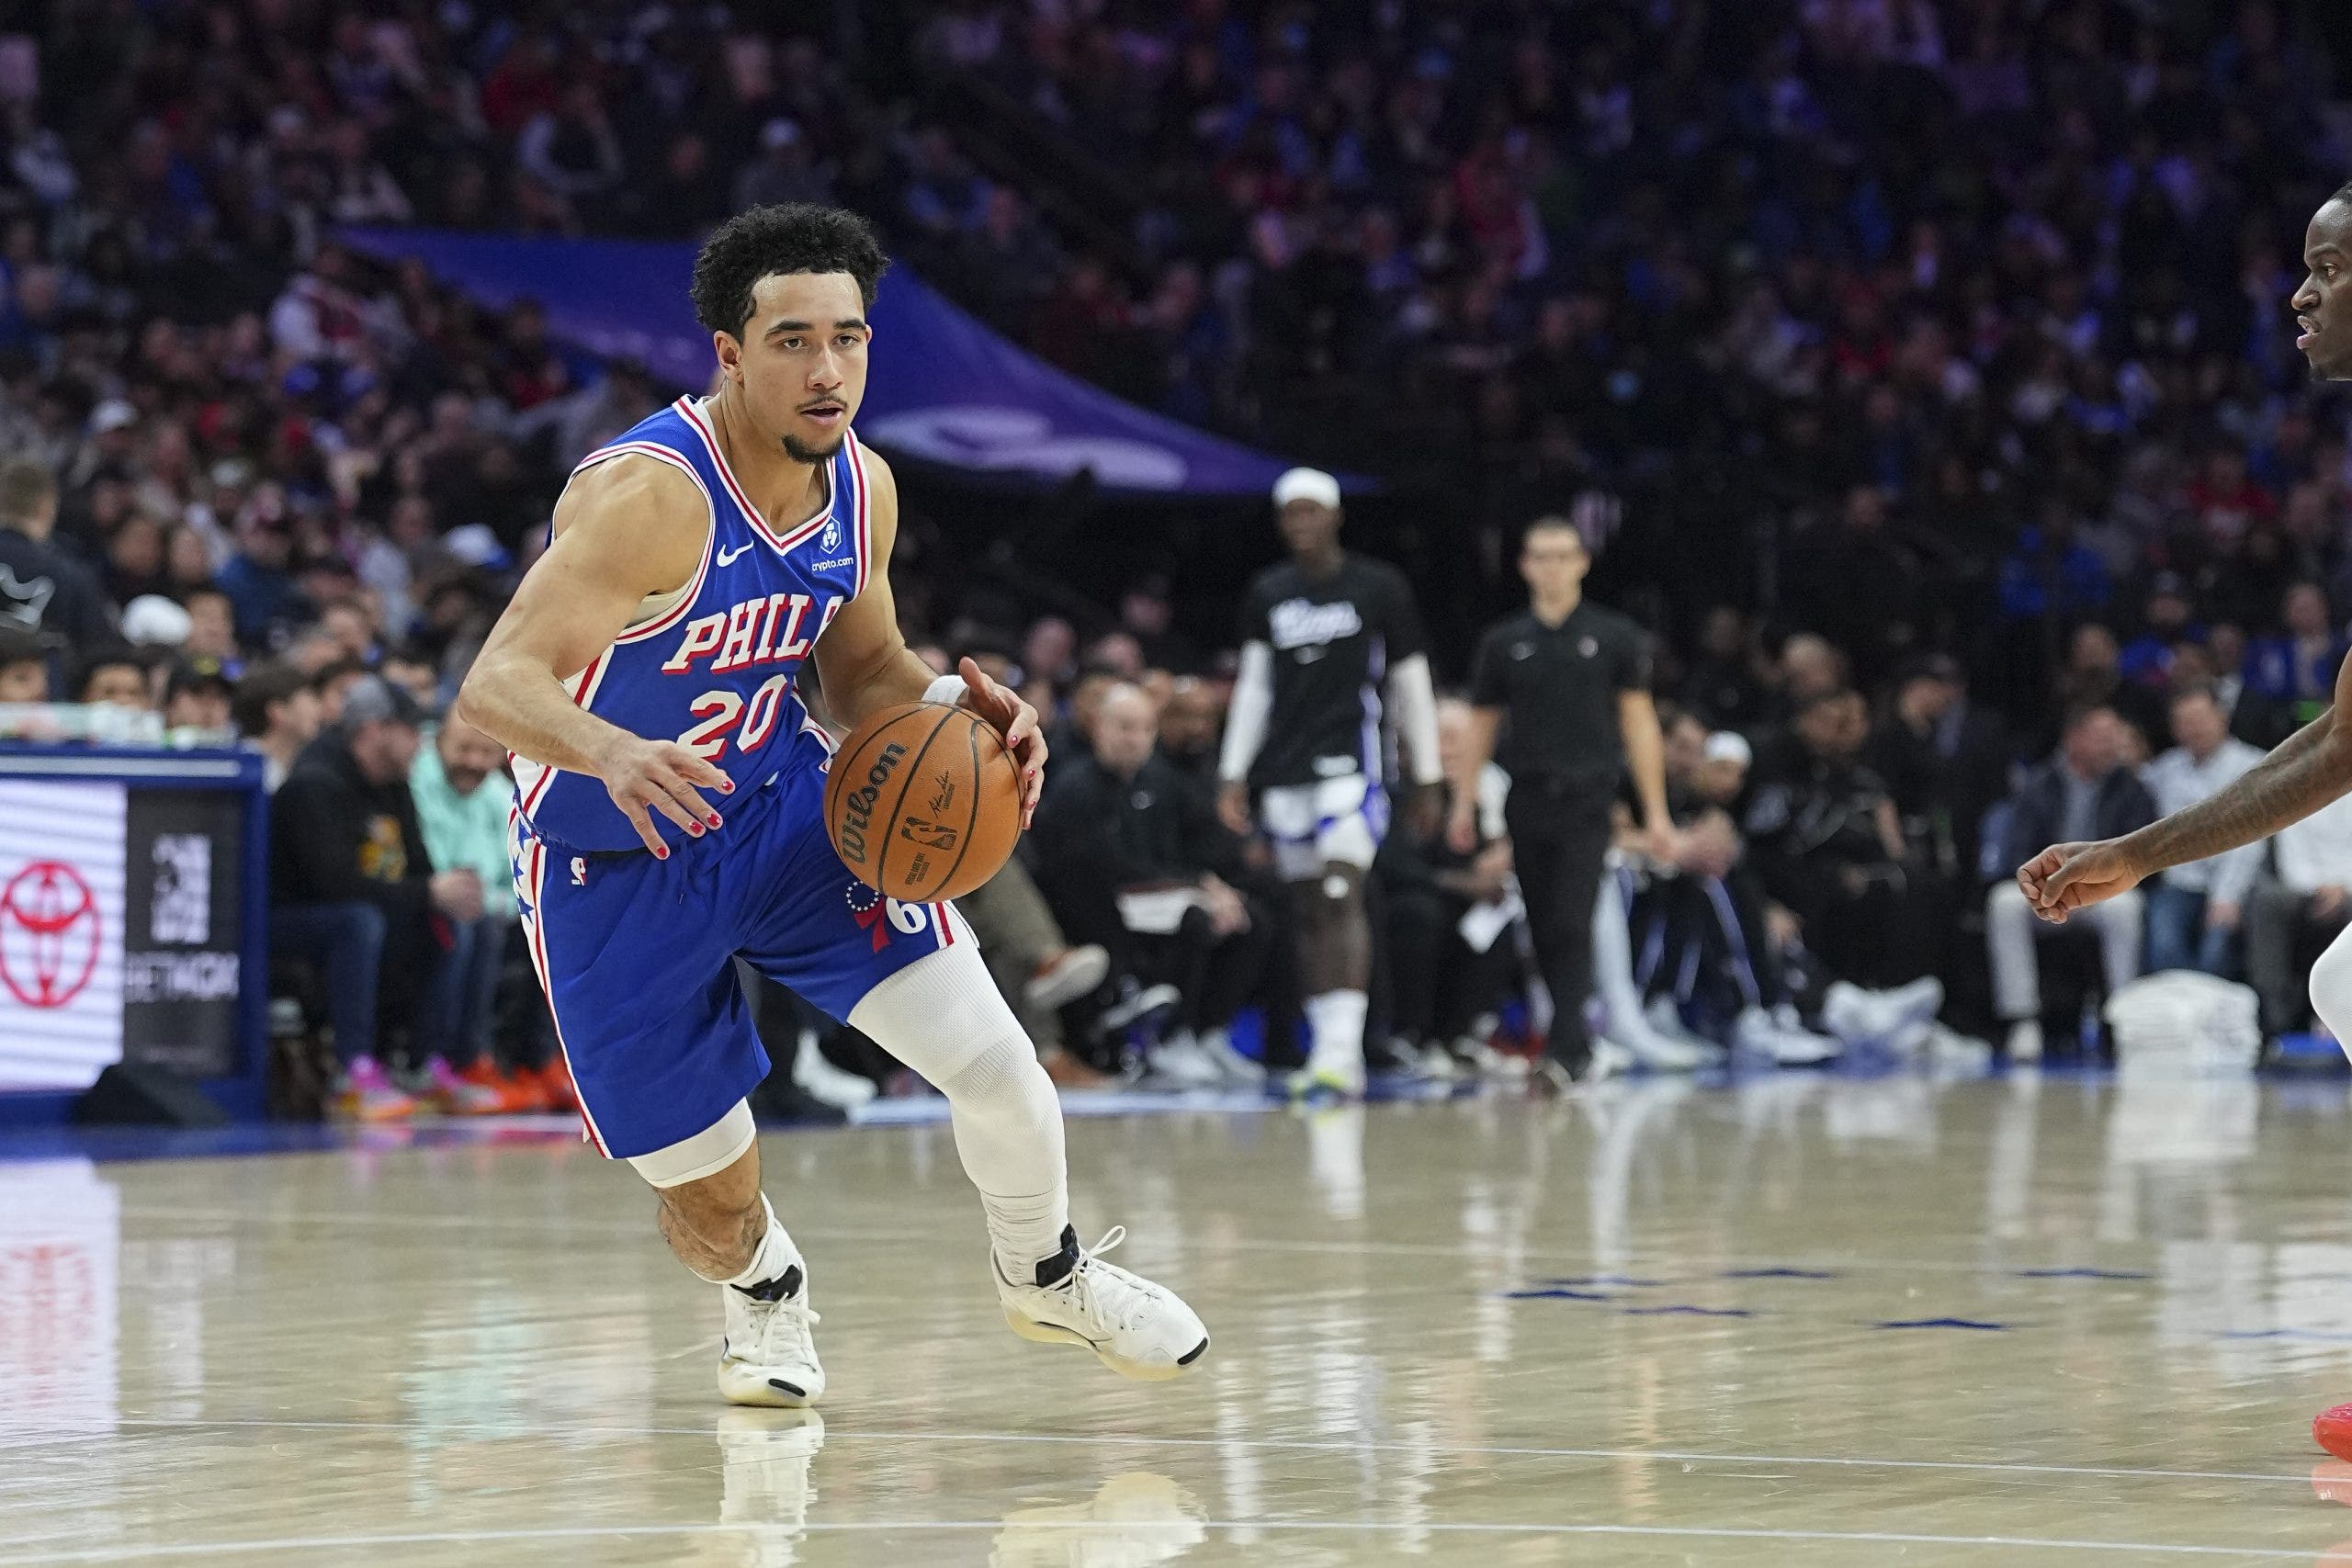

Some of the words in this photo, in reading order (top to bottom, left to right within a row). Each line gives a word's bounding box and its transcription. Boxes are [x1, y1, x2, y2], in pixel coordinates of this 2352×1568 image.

[811, 557, 854, 572] crypto.com
[675, 673, 787, 761] 20
[842, 742, 910, 864] Wilson
